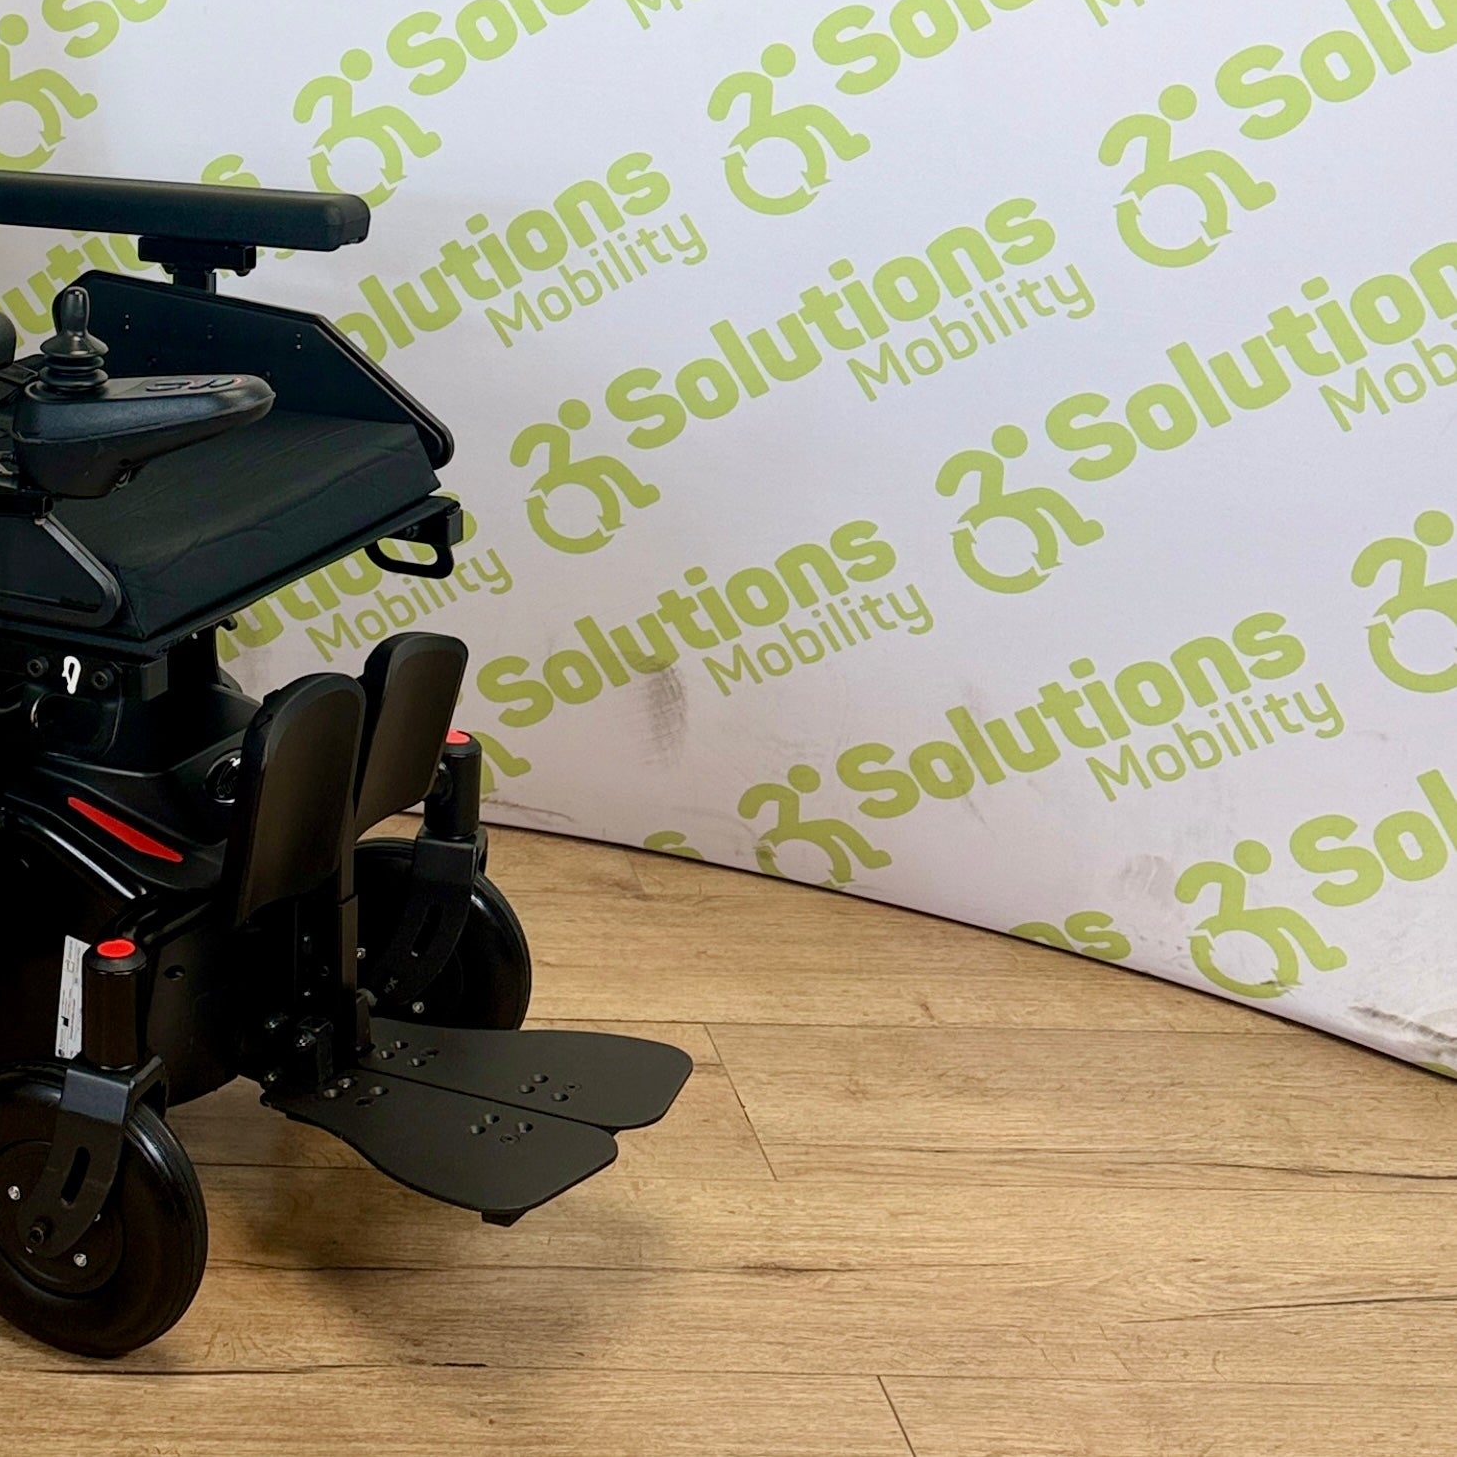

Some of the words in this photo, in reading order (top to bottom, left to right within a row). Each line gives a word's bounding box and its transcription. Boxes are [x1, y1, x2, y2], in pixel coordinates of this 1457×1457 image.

[484, 214, 707, 349] Mobility
[605, 198, 1055, 449] Solutions
[846, 264, 1095, 402] Mobility
[305, 548, 513, 662] Mobility
[477, 520, 895, 727] Solutions
[702, 584, 933, 696] Mobility
[836, 612, 1305, 818] Solutions
[1086, 682, 1345, 801] Mobility
